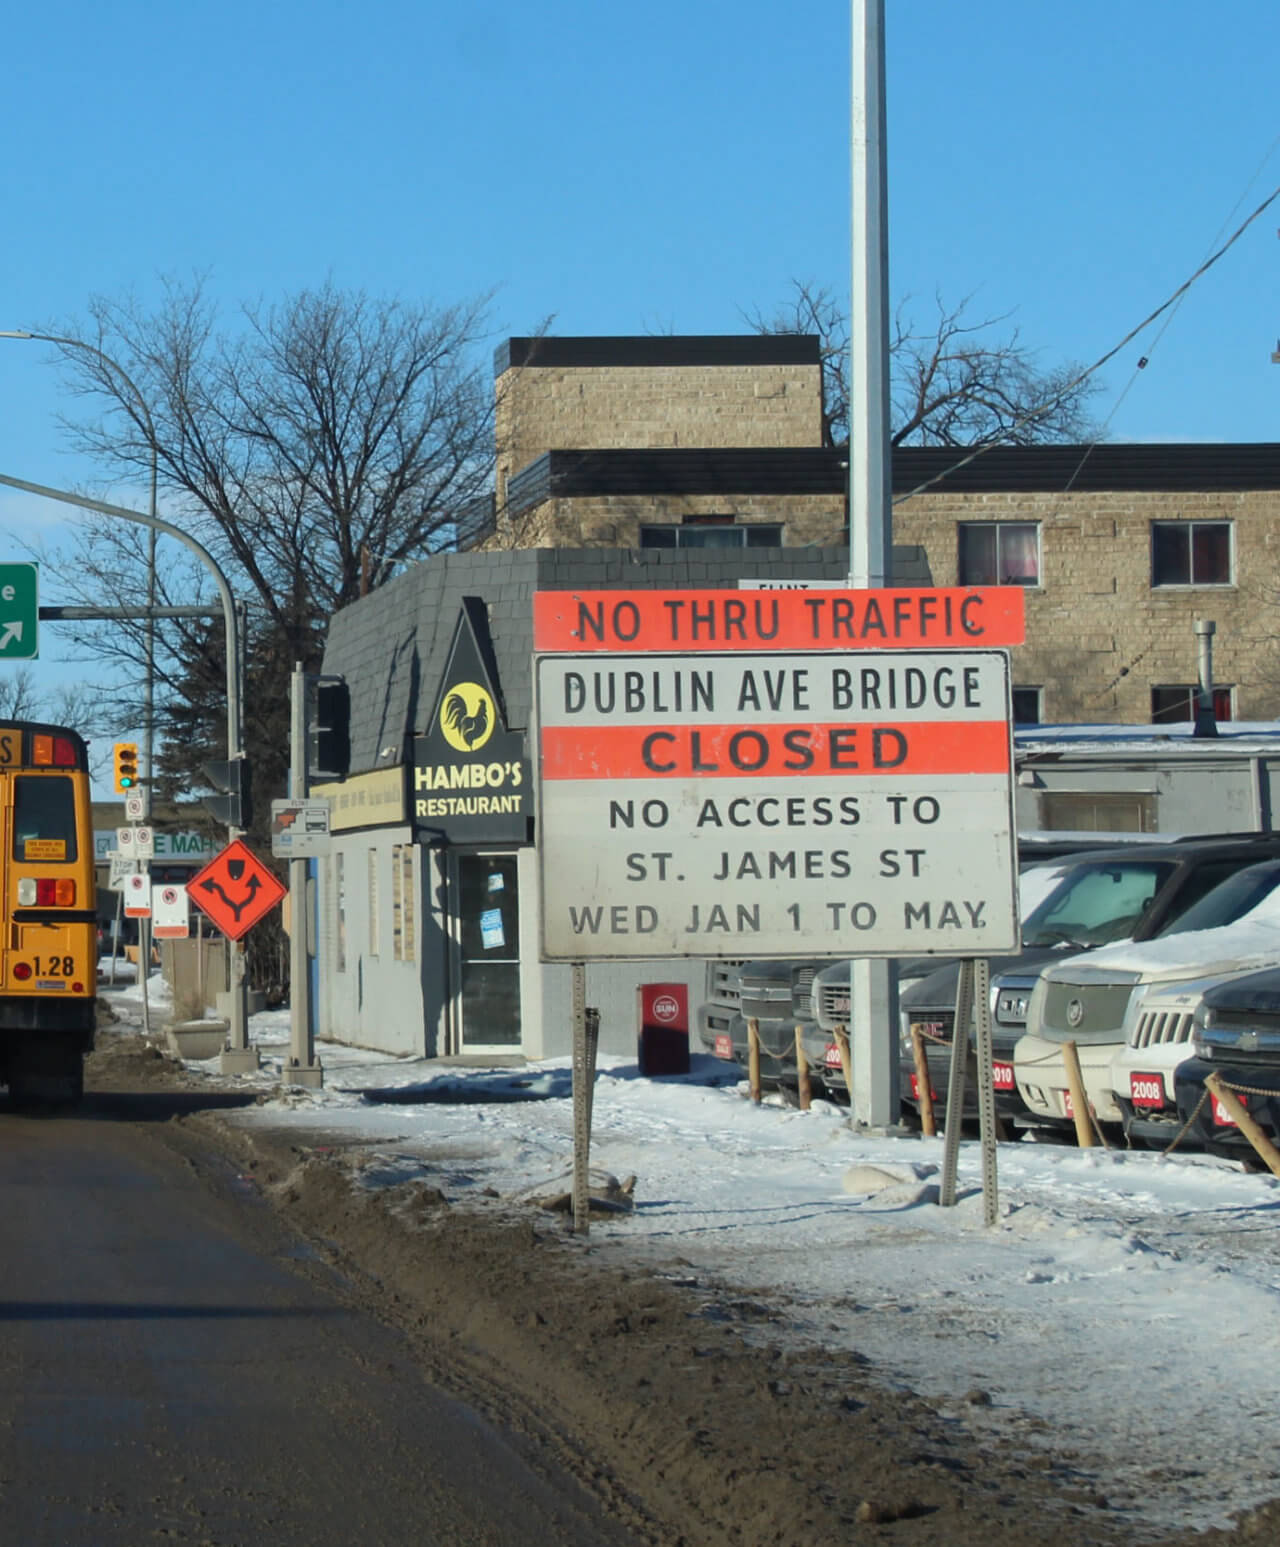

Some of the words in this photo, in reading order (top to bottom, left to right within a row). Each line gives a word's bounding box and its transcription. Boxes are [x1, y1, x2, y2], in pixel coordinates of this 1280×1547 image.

[577, 600, 641, 641] NO
[664, 599, 780, 640] THRU
[805, 595, 985, 639] TRAFFIC
[564, 670, 715, 714] DUBLIN
[737, 669, 809, 712] AVE
[833, 666, 982, 711] BRIDGE
[642, 727, 909, 773] CLOSED
[415, 762, 522, 790] HAMBO'S
[416, 795, 522, 817] RESTAURANT
[609, 799, 669, 828] NO
[697, 797, 861, 827] ACCESS
[886, 796, 940, 825] TO
[626, 853, 685, 881] ST.
[713, 850, 852, 881] JAMES
[879, 849, 927, 878] ST
[569, 905, 659, 935] WED
[686, 904, 761, 933] JAN
[787, 904, 801, 932] 1
[826, 902, 877, 931] TO
[904, 901, 986, 929] MAY
[33, 955, 74, 977] 1.28
[655, 1004, 676, 1013] SUN
[992, 1066, 1013, 1083] 010
[1132, 1081, 1160, 1100] 2008
